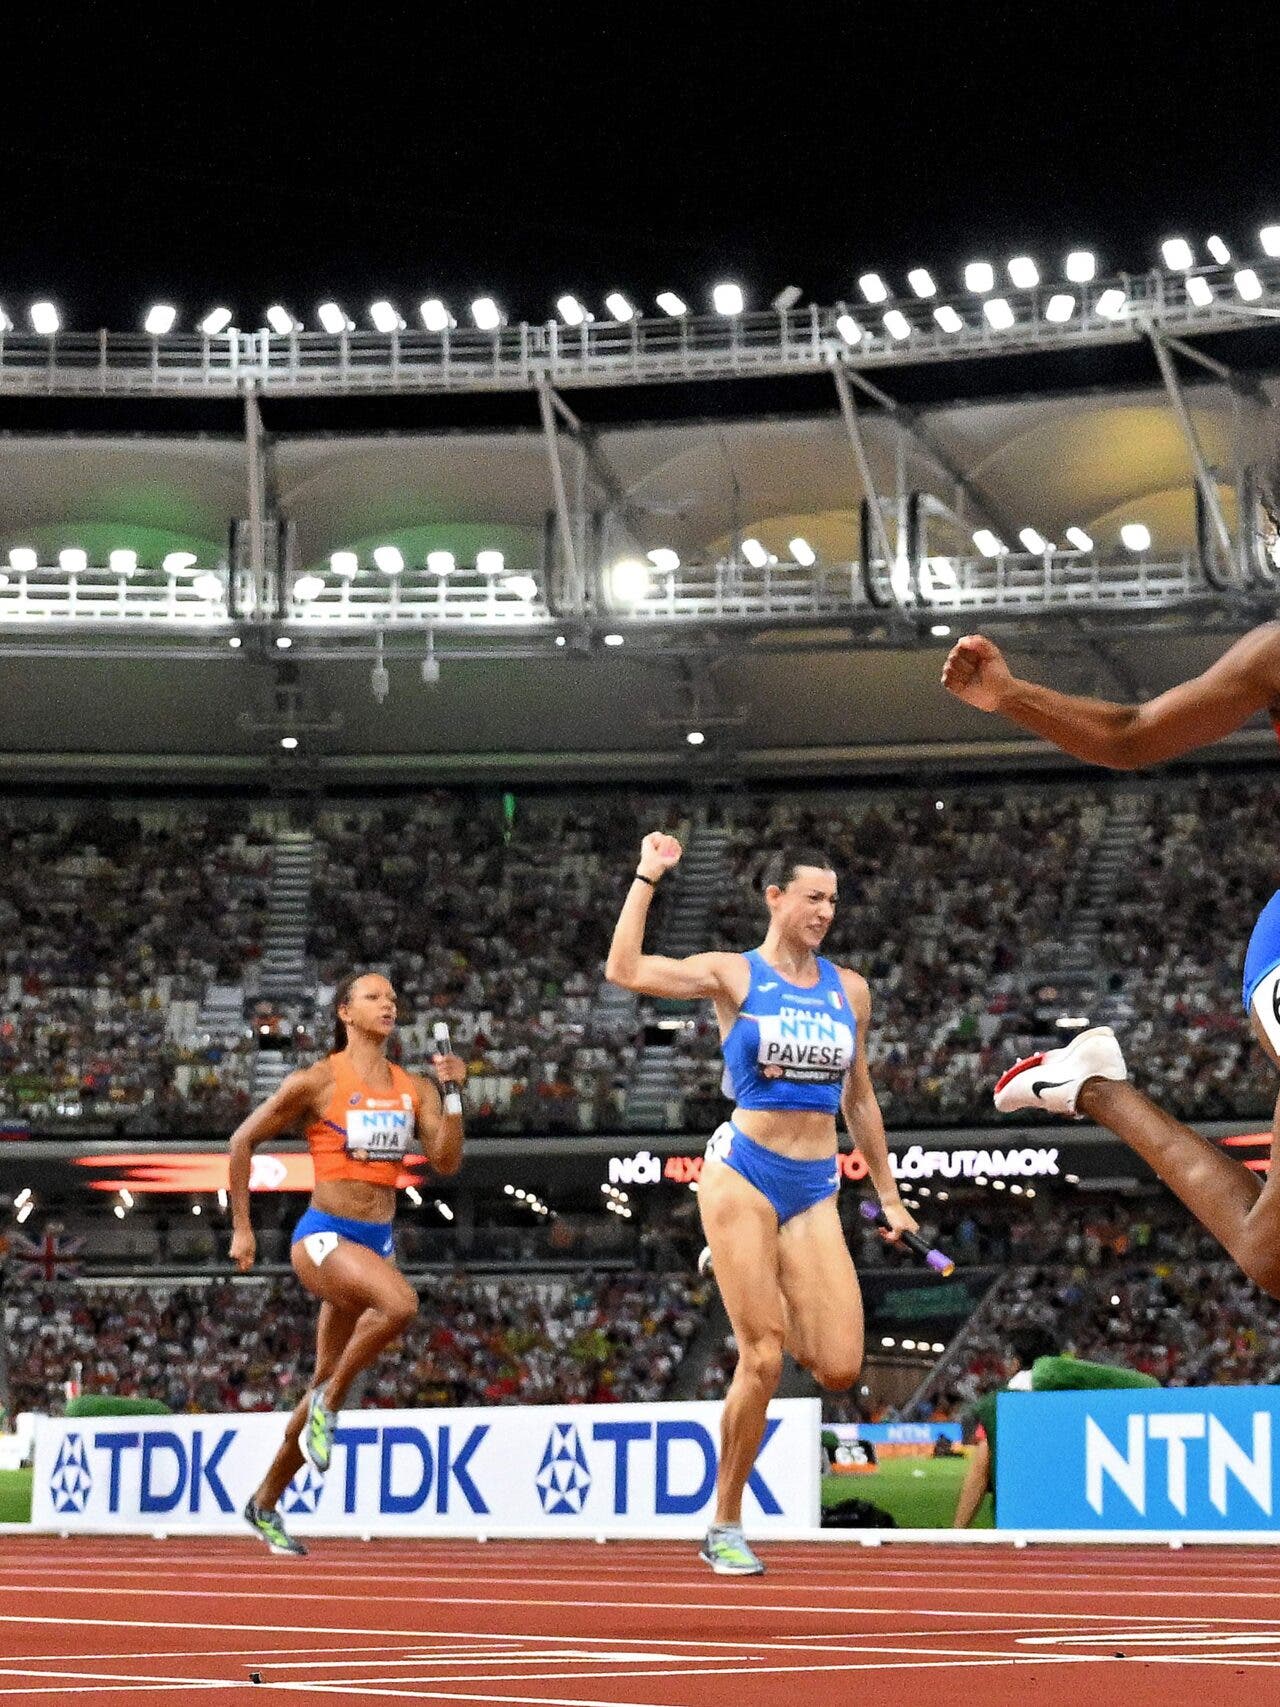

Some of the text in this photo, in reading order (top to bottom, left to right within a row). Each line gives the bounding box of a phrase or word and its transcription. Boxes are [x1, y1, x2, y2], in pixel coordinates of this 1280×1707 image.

[781, 1019, 837, 1041] NTN
[767, 1042, 843, 1066] PAVESE
[363, 1112, 407, 1127] NTN
[888, 1146, 1059, 1179] LŐFUTAMOK
[94, 1430, 237, 1513] TDK
[333, 1424, 491, 1513] TDK
[1085, 1411, 1273, 1517] NTN
